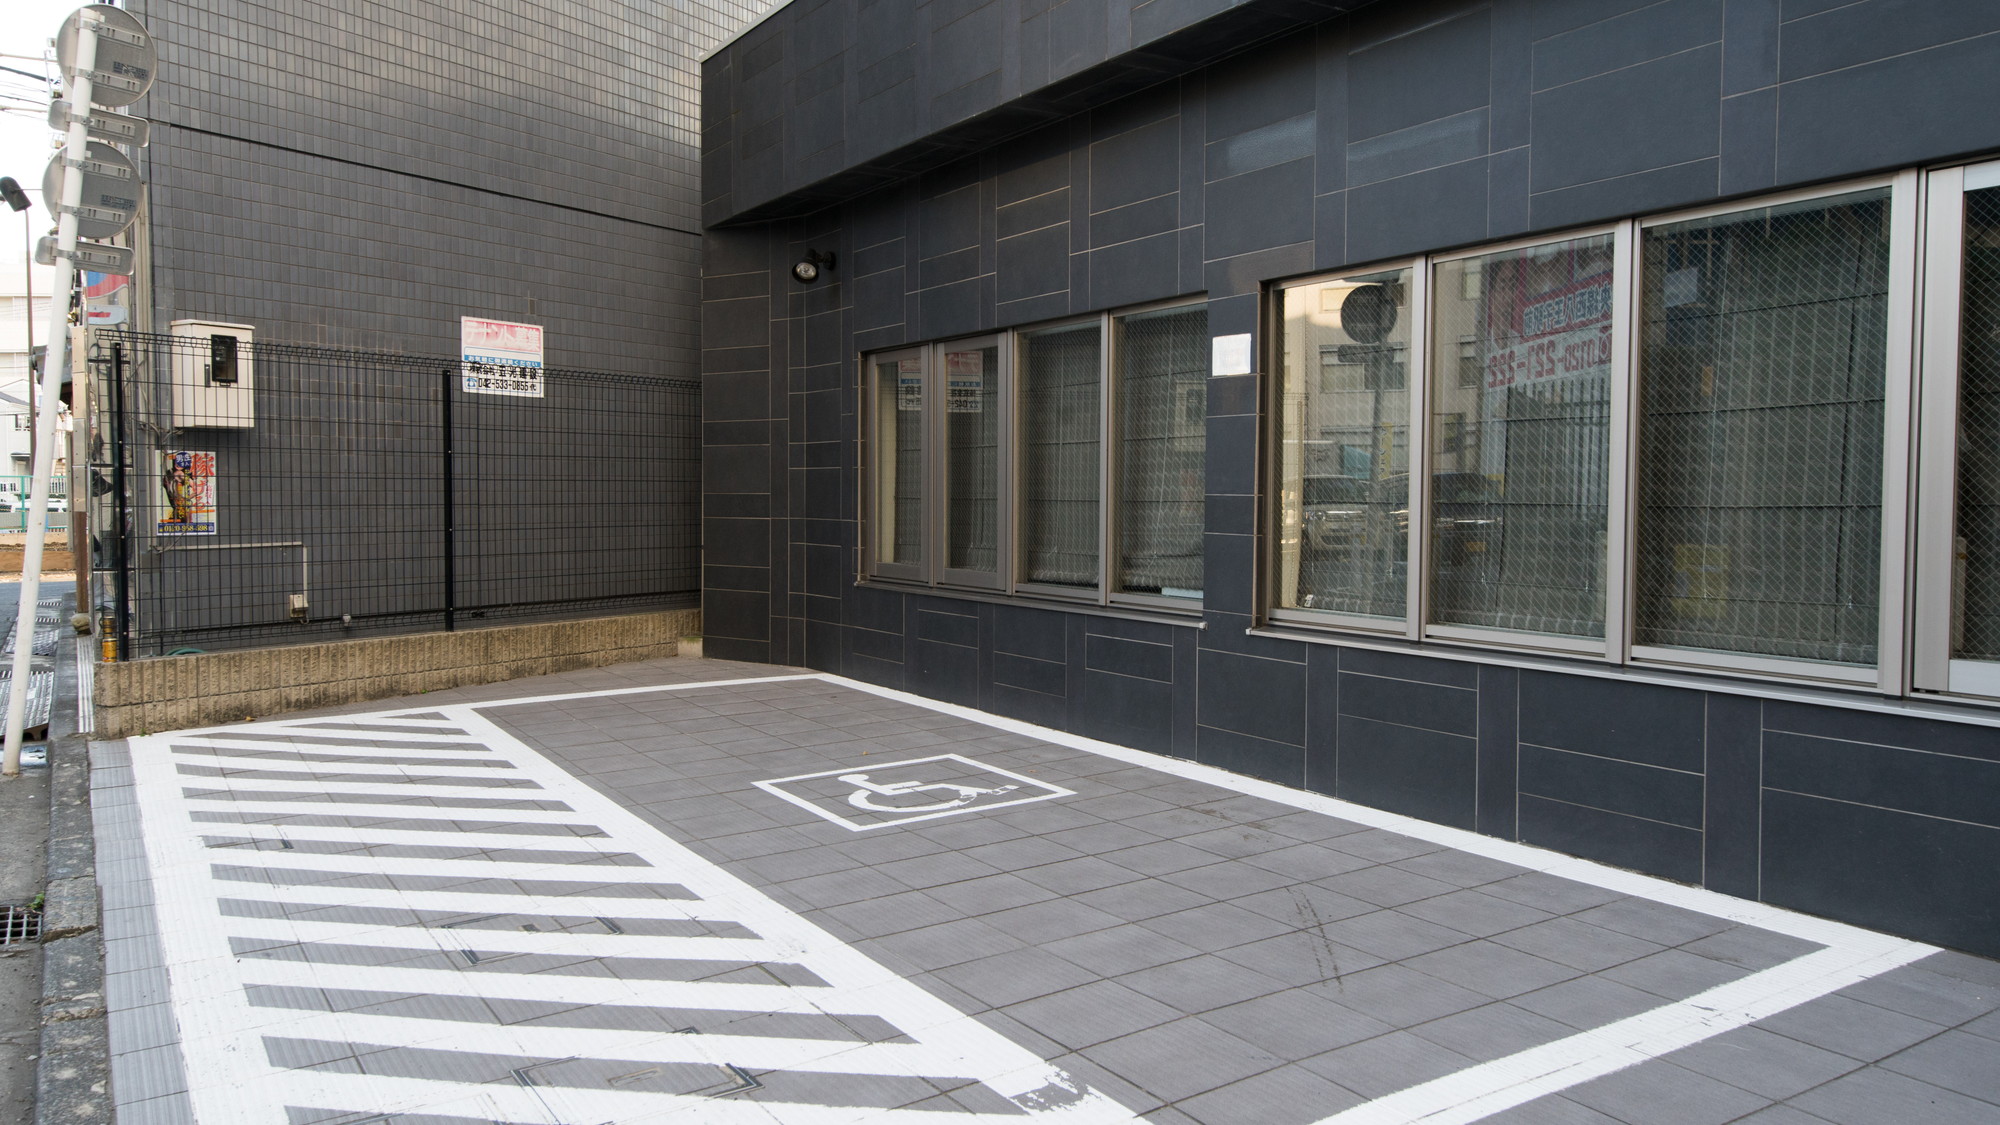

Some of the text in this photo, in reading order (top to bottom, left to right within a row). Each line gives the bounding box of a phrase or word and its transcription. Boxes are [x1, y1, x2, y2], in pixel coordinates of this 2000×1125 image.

[464, 321, 540, 351] テナント募集
